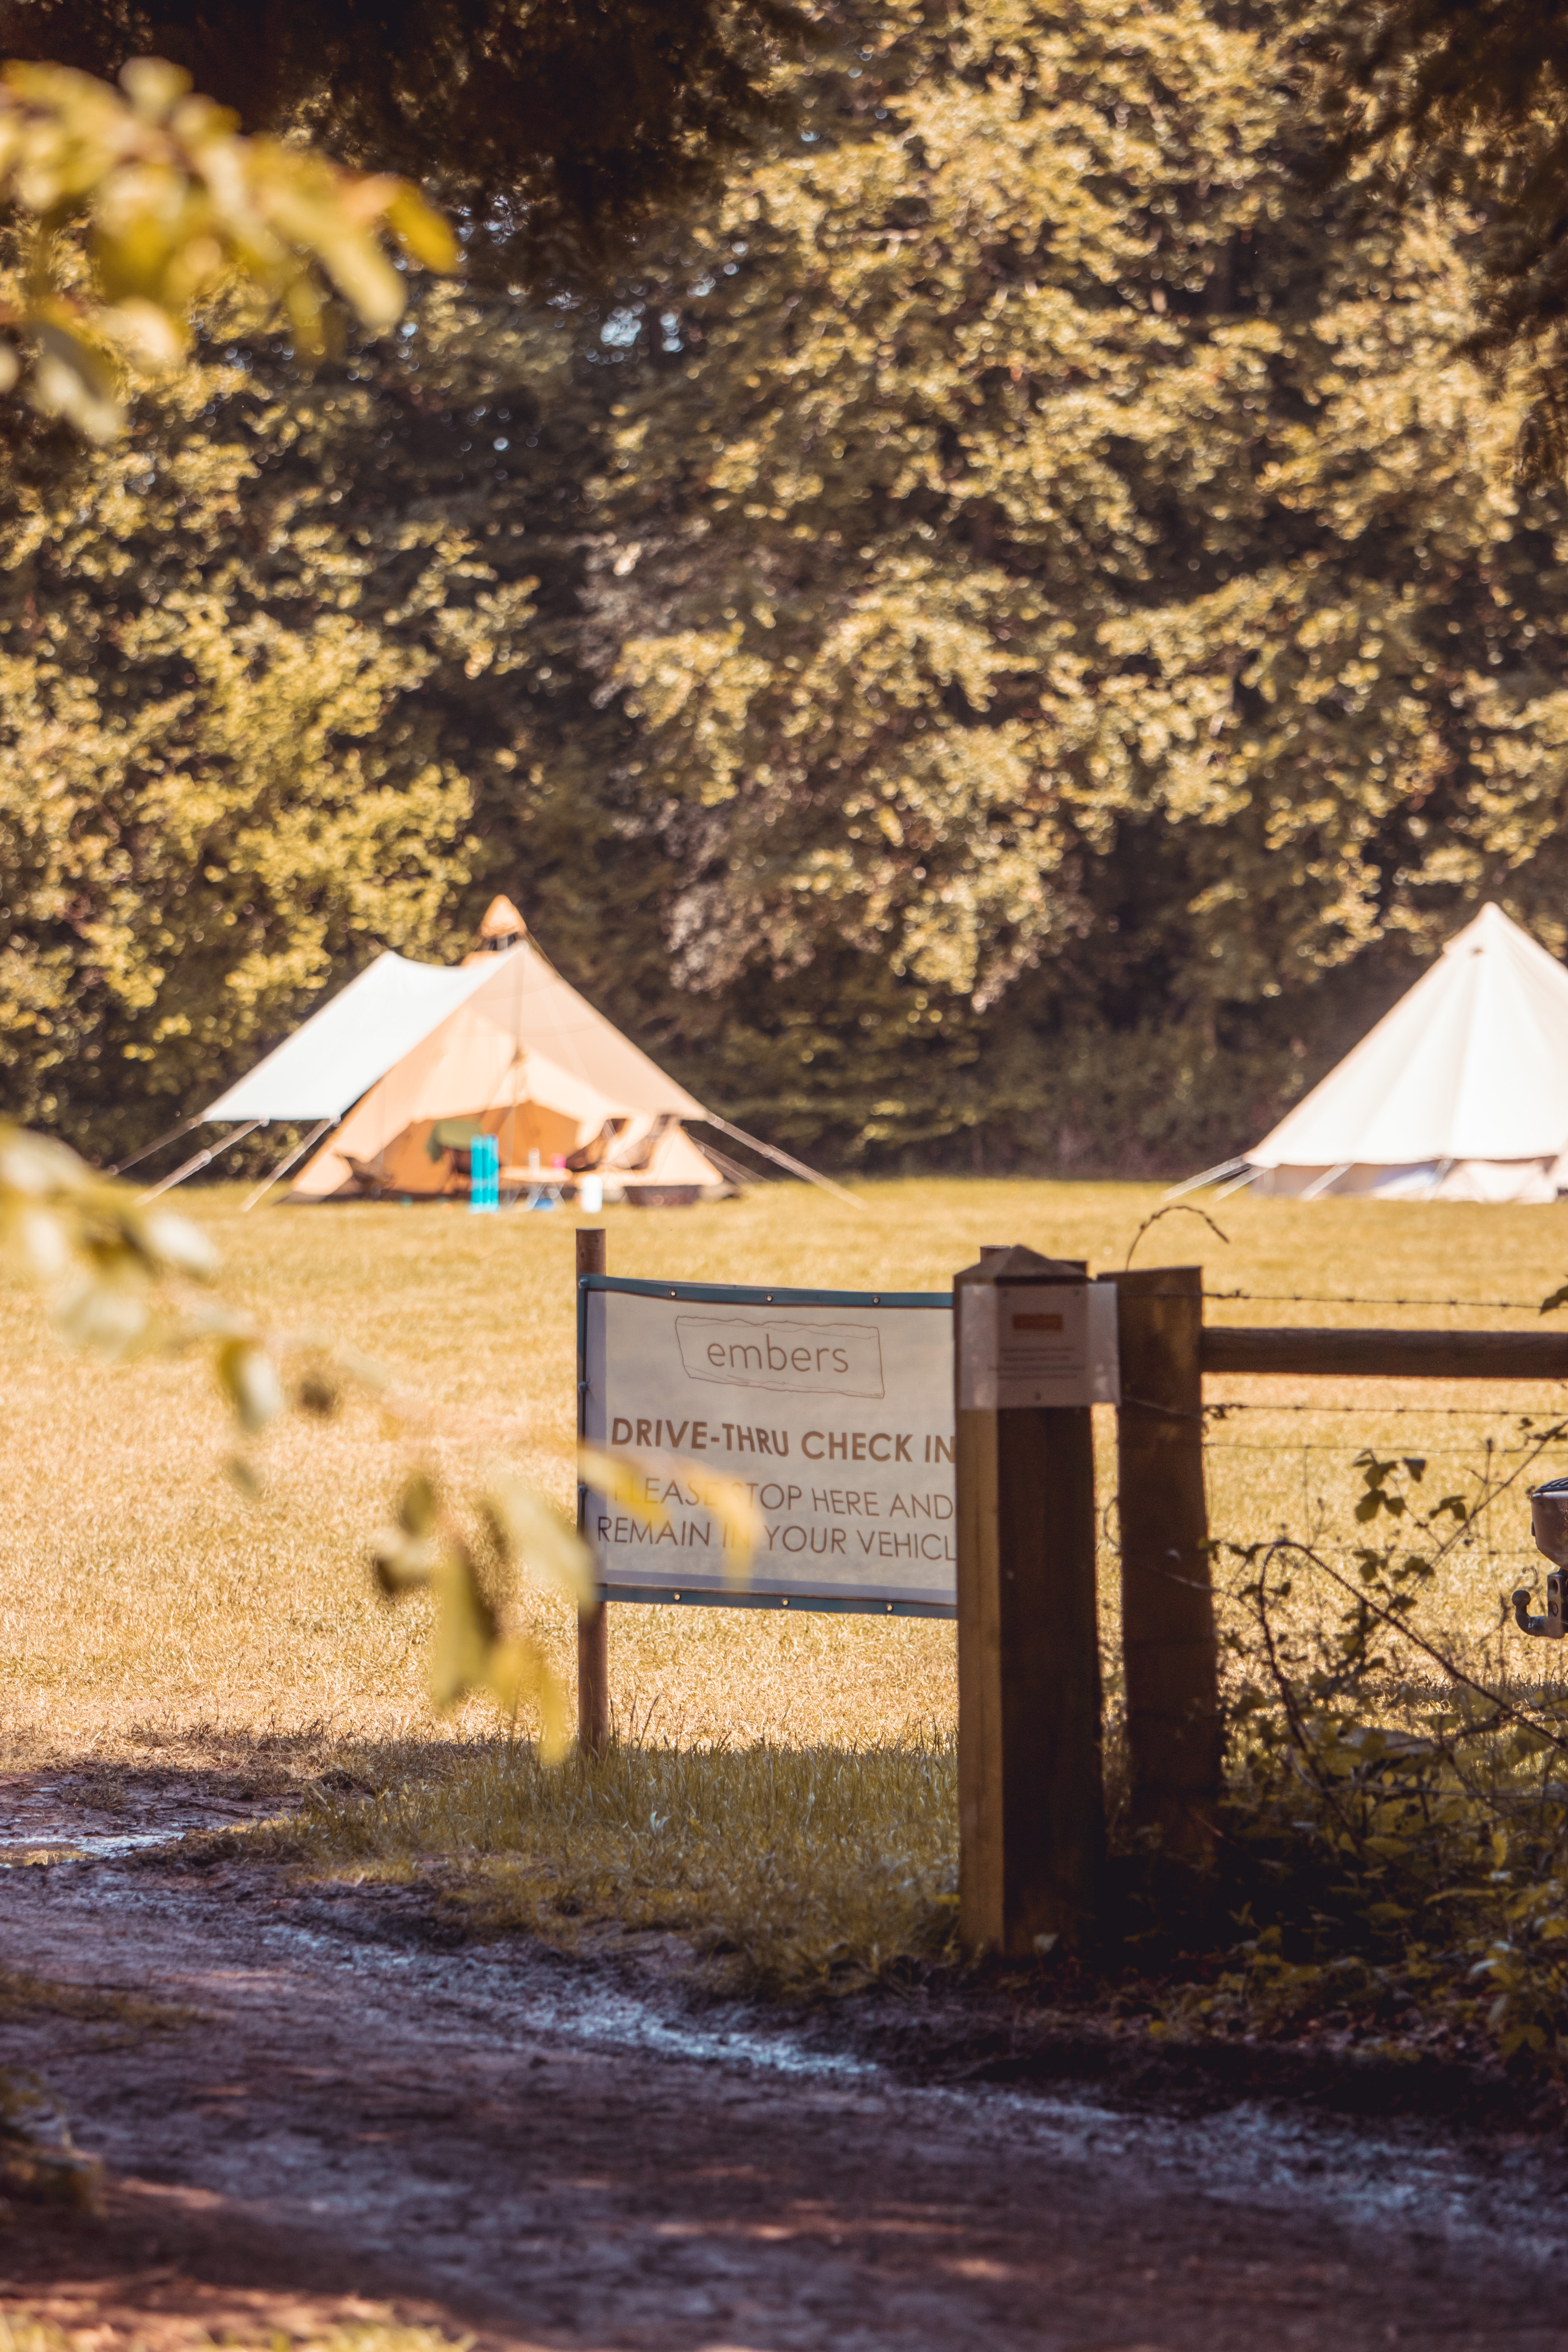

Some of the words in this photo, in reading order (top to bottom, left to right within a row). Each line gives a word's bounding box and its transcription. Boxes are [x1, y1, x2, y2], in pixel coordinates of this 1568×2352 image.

[707, 1333, 849, 1373] embers
[611, 1417, 789, 1457] DRIVE-THRU
[801, 1431, 913, 1462] CHECK
[925, 1435, 956, 1464] IN
[811, 1488, 880, 1517] HERE
[889, 1493, 954, 1520] AND
[597, 1516, 711, 1547] REMAIN
[763, 1525, 847, 1555] YOUR
[856, 1530, 957, 1561] VEHICL
